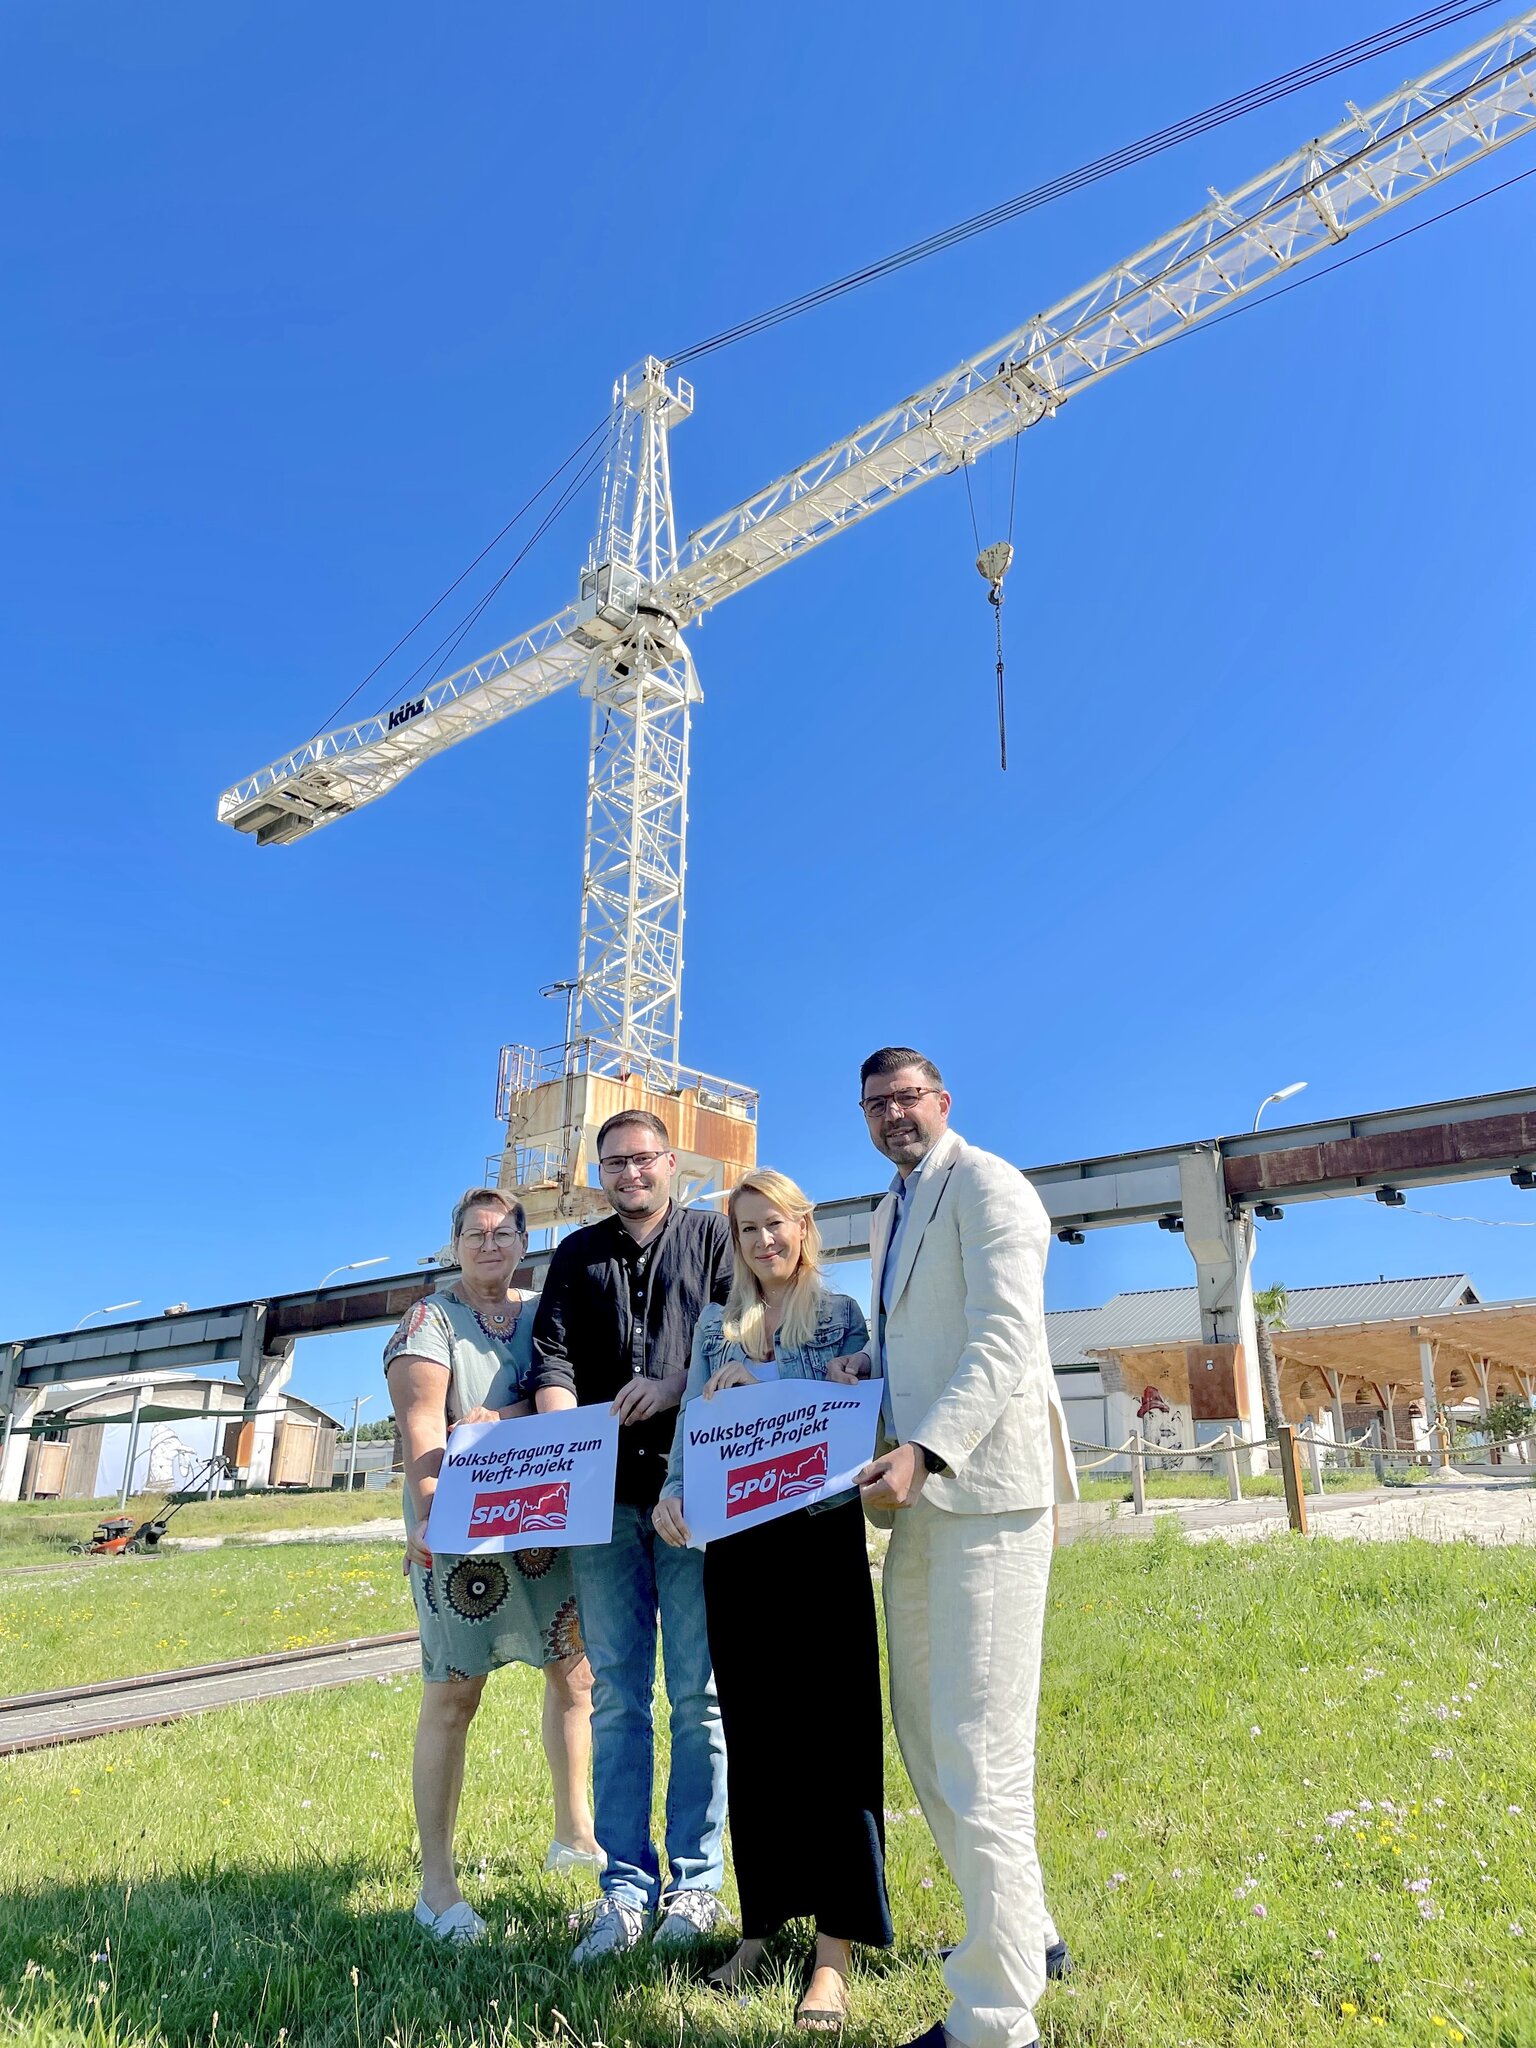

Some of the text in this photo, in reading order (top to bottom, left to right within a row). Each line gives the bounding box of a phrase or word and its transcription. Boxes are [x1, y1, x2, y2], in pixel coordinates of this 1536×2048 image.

[689, 1401, 862, 1446] Volksbefragung zum
[719, 1417, 830, 1461] Werft-Projekt
[448, 1438, 603, 1468] Volksbefragung zum
[471, 1457, 575, 1485] Werft-Projekt
[727, 1468, 777, 1504] SPÖ
[470, 1498, 521, 1525] SPÖ
